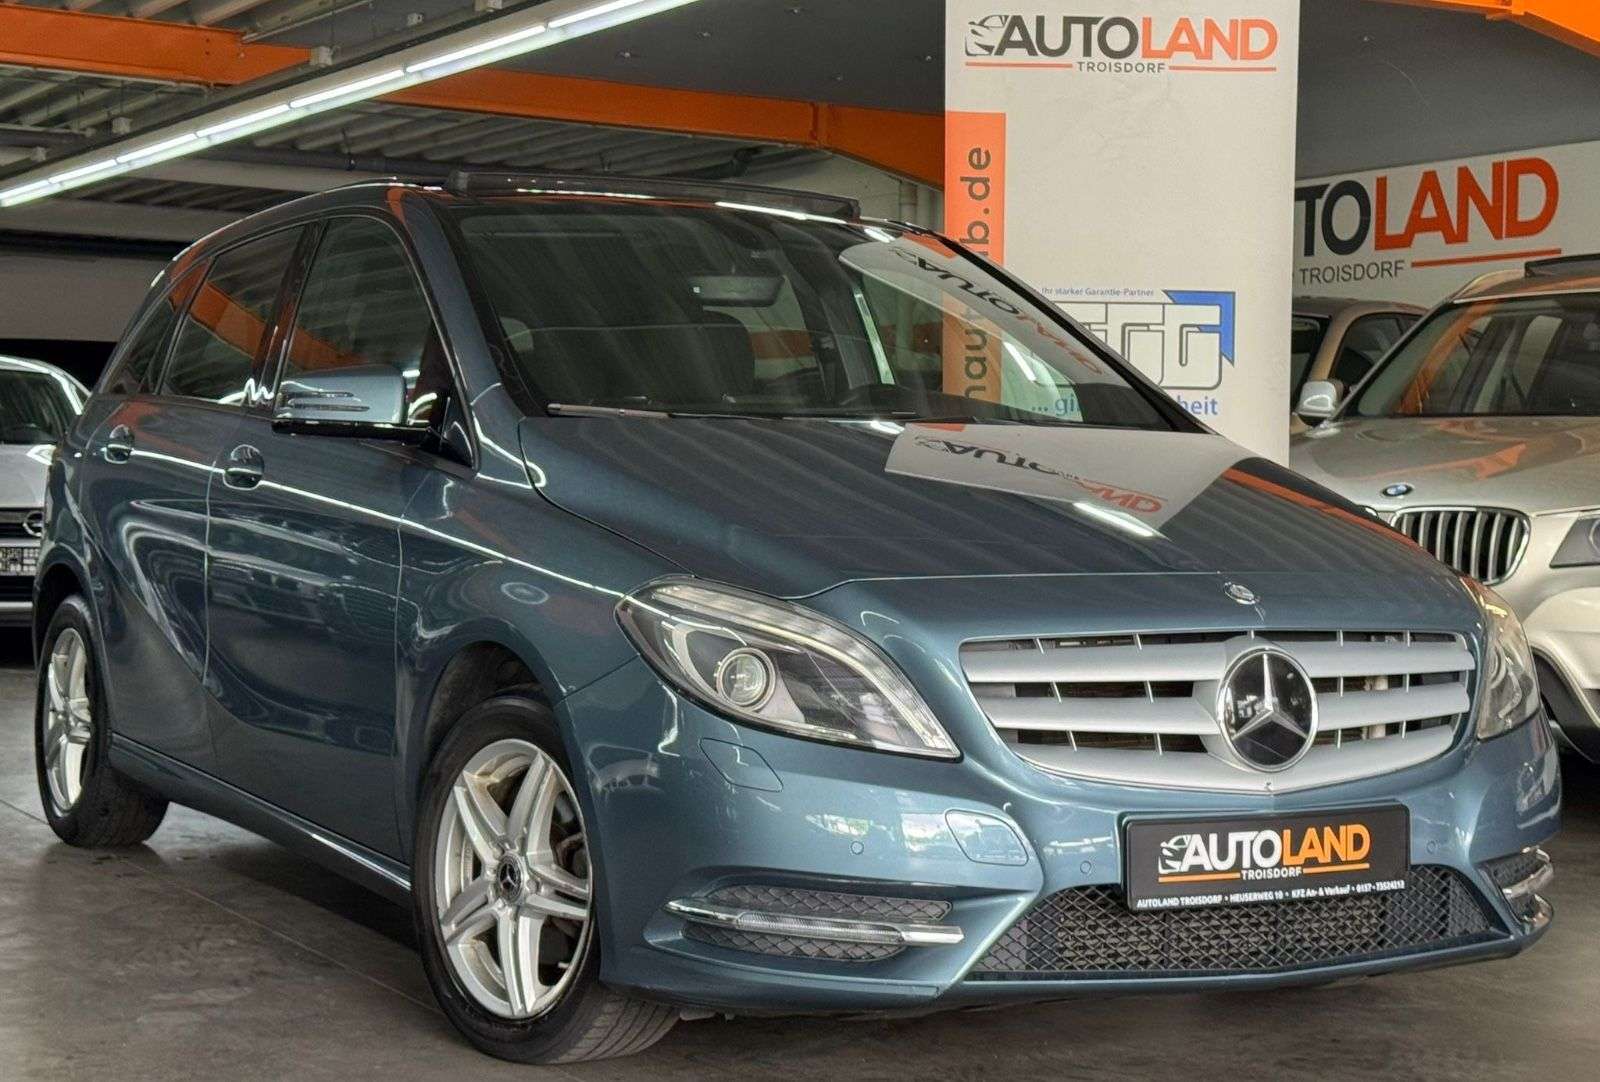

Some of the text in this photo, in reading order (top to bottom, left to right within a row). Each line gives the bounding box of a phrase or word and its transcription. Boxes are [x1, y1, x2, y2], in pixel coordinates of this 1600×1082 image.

[994, 15, 1278, 61] AUTOLAND
[1078, 61, 1166, 74] TROISDORF
[1295, 157, 1560, 257] TOLAND
[1300, 260, 1405, 286] TROISDORF
[1054, 287, 1084, 297] starker
[1085, 287, 1155, 298] Garantie-Partner
[1178, 396, 1218, 415] heit
[1179, 823, 1371, 873] AUTOLAND
[1241, 866, 1304, 881] TROISDORF
[1137, 896, 1179, 908] AUTOLAND
[1180, 894, 1222, 906] TROISDORF
[1230, 890, 1274, 903] HEUSERWEG
